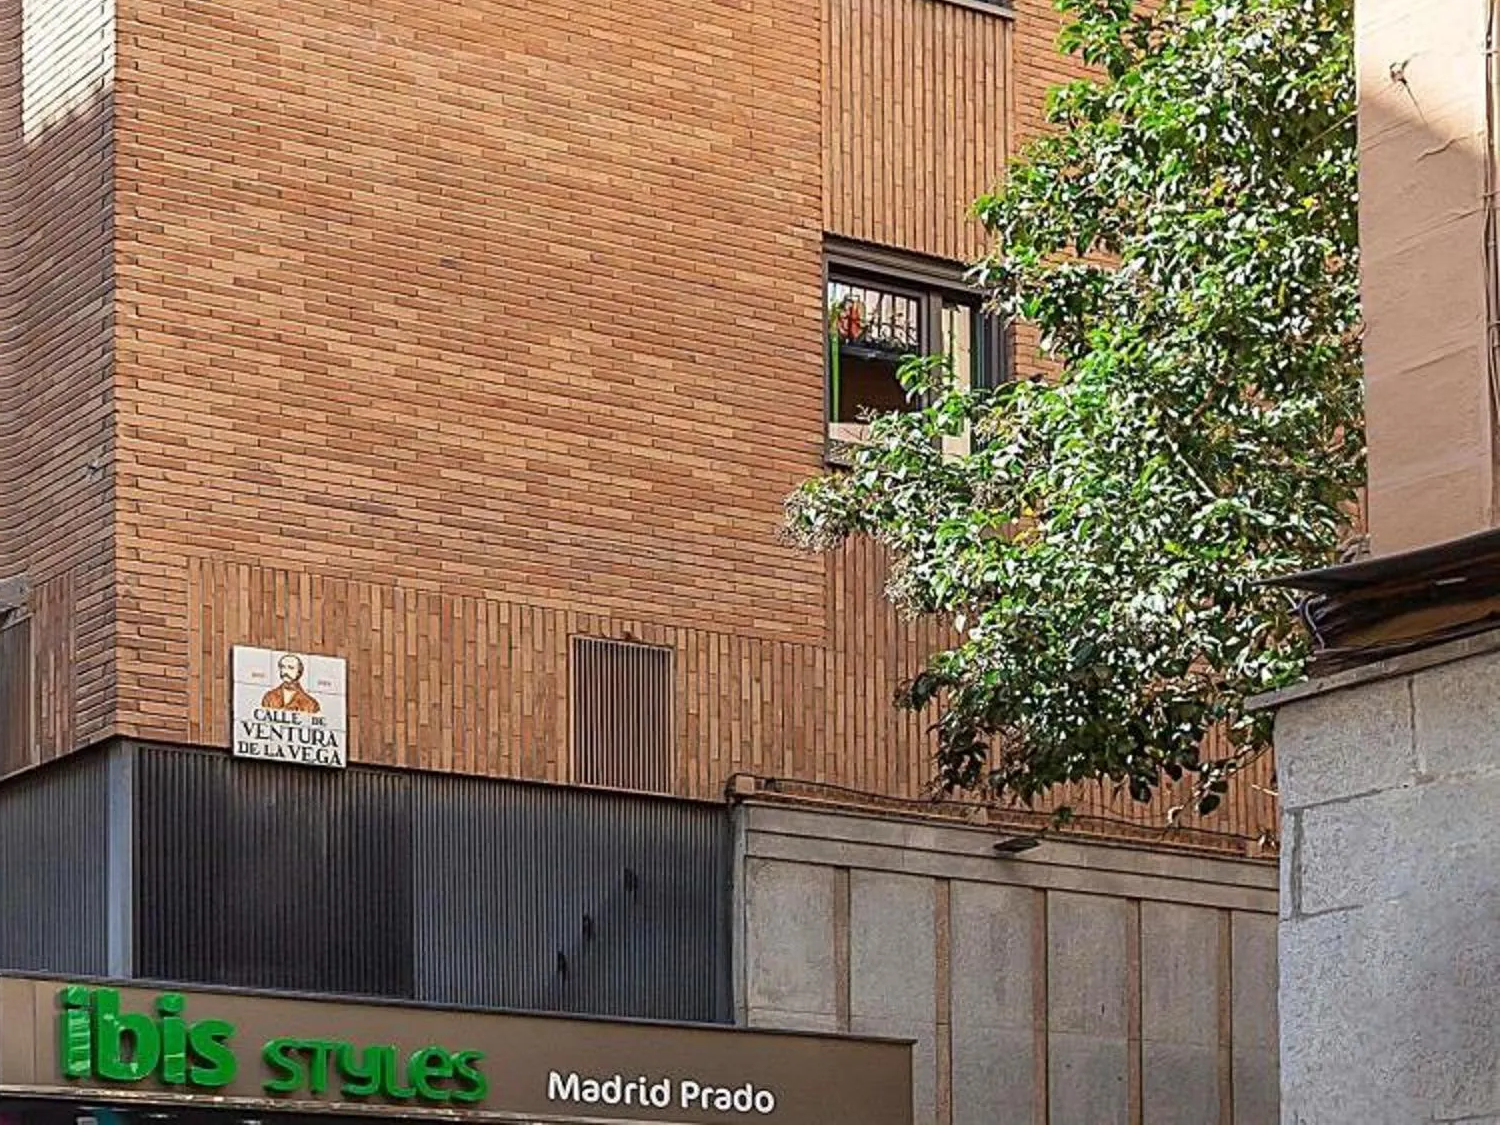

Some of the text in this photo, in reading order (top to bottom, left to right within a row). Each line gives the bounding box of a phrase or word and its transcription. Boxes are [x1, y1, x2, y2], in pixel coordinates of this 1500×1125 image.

[253, 708, 326, 726] CALLE DE
[238, 741, 260, 755] DE
[241, 720, 338, 748] VENTURA
[55, 985, 237, 1088] ibis
[547, 1070, 776, 1114] Madrid Prado
